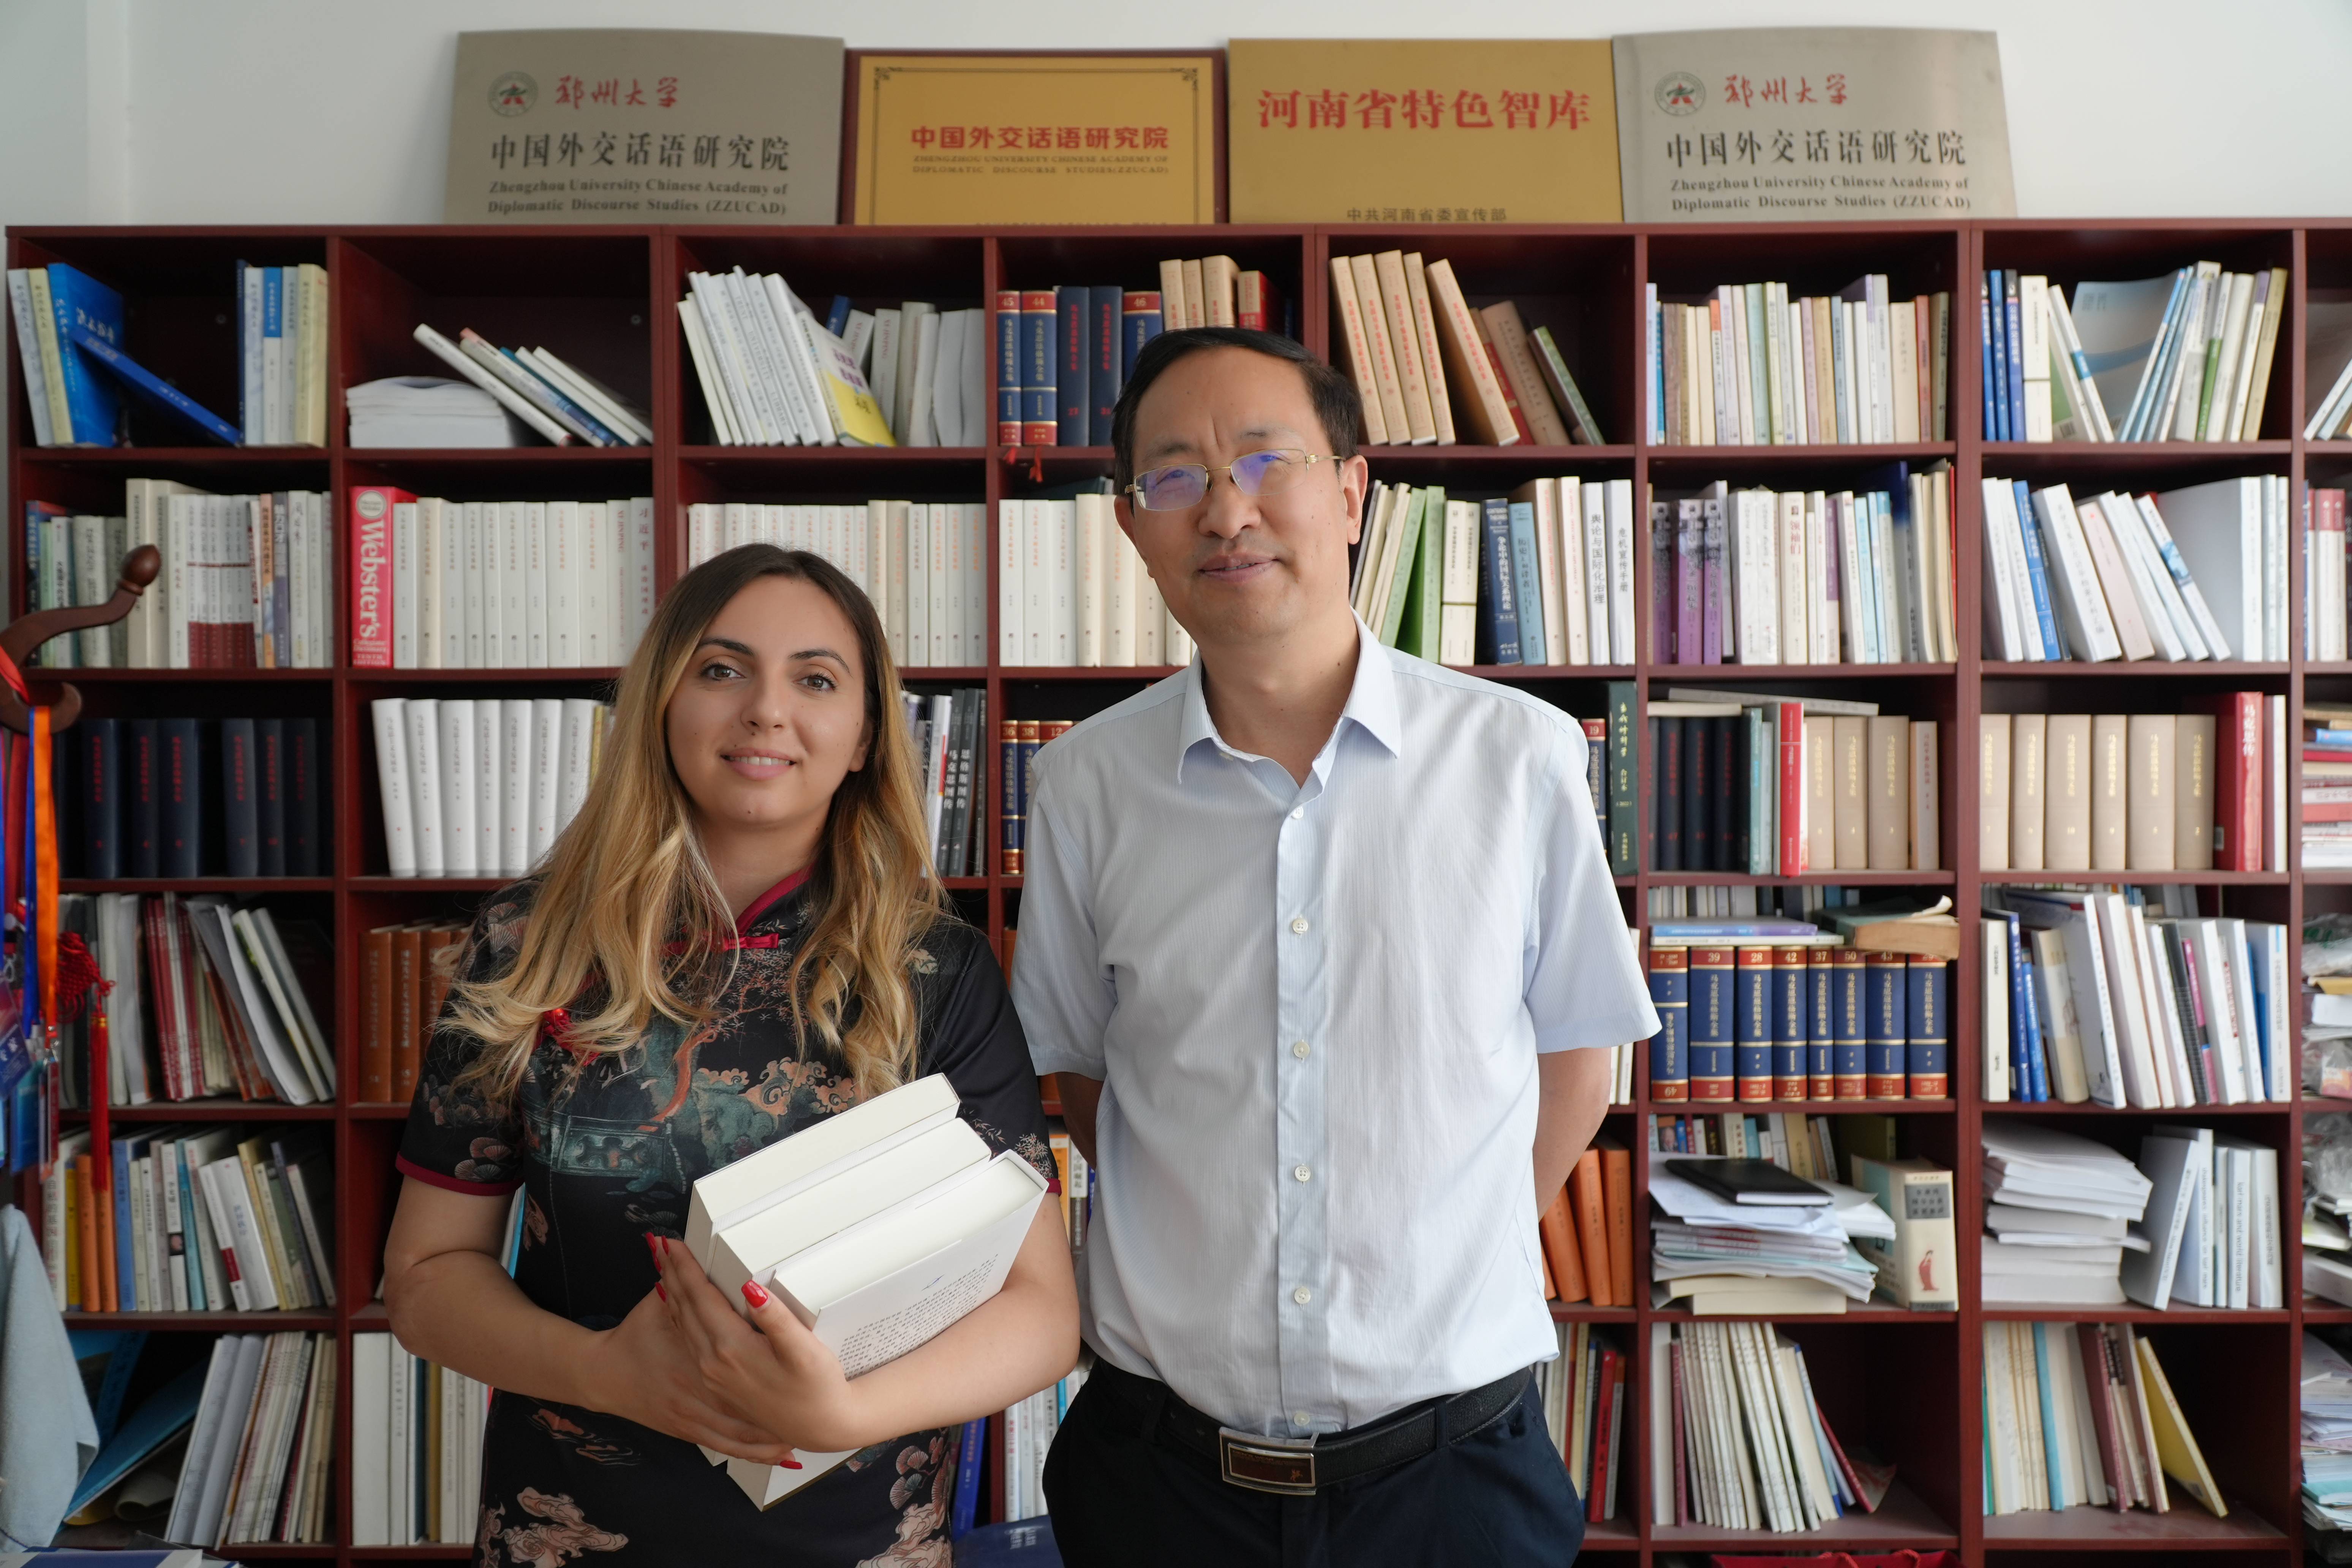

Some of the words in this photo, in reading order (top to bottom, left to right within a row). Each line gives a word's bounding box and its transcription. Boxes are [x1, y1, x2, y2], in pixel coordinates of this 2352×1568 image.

[554, 76, 680, 108] 郑州大学
[1724, 74, 1849, 108] 郑州大学
[1258, 89, 1591, 130] 河南省特色智库
[911, 126, 1169, 150] 中国外交话语研究院
[490, 131, 790, 171] 中国外交话语研究院
[1666, 129, 1967, 168] 中国外交话语研究院
[489, 179, 564, 194] Zhengzhou
[569, 179, 642, 193] University
[645, 179, 702, 192] Chinese
[704, 180, 769, 196] Academy
[773, 183, 788, 195] of
[1670, 176, 1749, 192] Zhengzhou
[1753, 175, 1826, 190] University
[1830, 175, 1886, 188] Chinese
[1889, 176, 1952, 191] Academy
[1955, 176, 1970, 189] of
[488, 199, 564, 216] Diplomatic
[571, 198, 640, 211] Discourse
[646, 198, 699, 212] Studies
[705, 198, 787, 215] (ZZUCAD)
[1672, 196, 1750, 213] Diplomatic
[1758, 196, 1827, 209] Discourse
[1834, 194, 1886, 208] Studies
[1893, 194, 1971, 211] (ZZUCAD)
[1347, 207, 1507, 223] 中共河南省委宣传部
[1001, 297, 1014, 307] 45
[1032, 297, 1045, 307] 44
[1133, 297, 1147, 307] 46
[640, 507, 650, 552] 习近平
[1790, 519, 1801, 556] 领袖们
[1518, 538, 1530, 588] 历史上的译者
[1591, 514, 1605, 604] 舆论与国际化治理
[1619, 527, 1628, 593] 危机宣传手册
[359, 520, 387, 639] Webster's
[1497, 535, 1511, 611] 争论中的国际关系理论
[1003, 726, 1015, 736] 36
[1022, 726, 1035, 736] 38
[1589, 726, 1599, 735] 19
[2243, 705, 2256, 757] 马克思传
[1708, 952, 1721, 963] 39
[1750, 952, 1763, 963] 28
[1785, 952, 1797, 963] 42
[1815, 951, 1827, 962] 37
[1844, 951, 1856, 962] 50
[1881, 952, 1894, 961] 43
[2237, 1182, 2246, 1195] karl
[2236, 1235, 2245, 1255] world
[2235, 1258, 2244, 1292] literature
